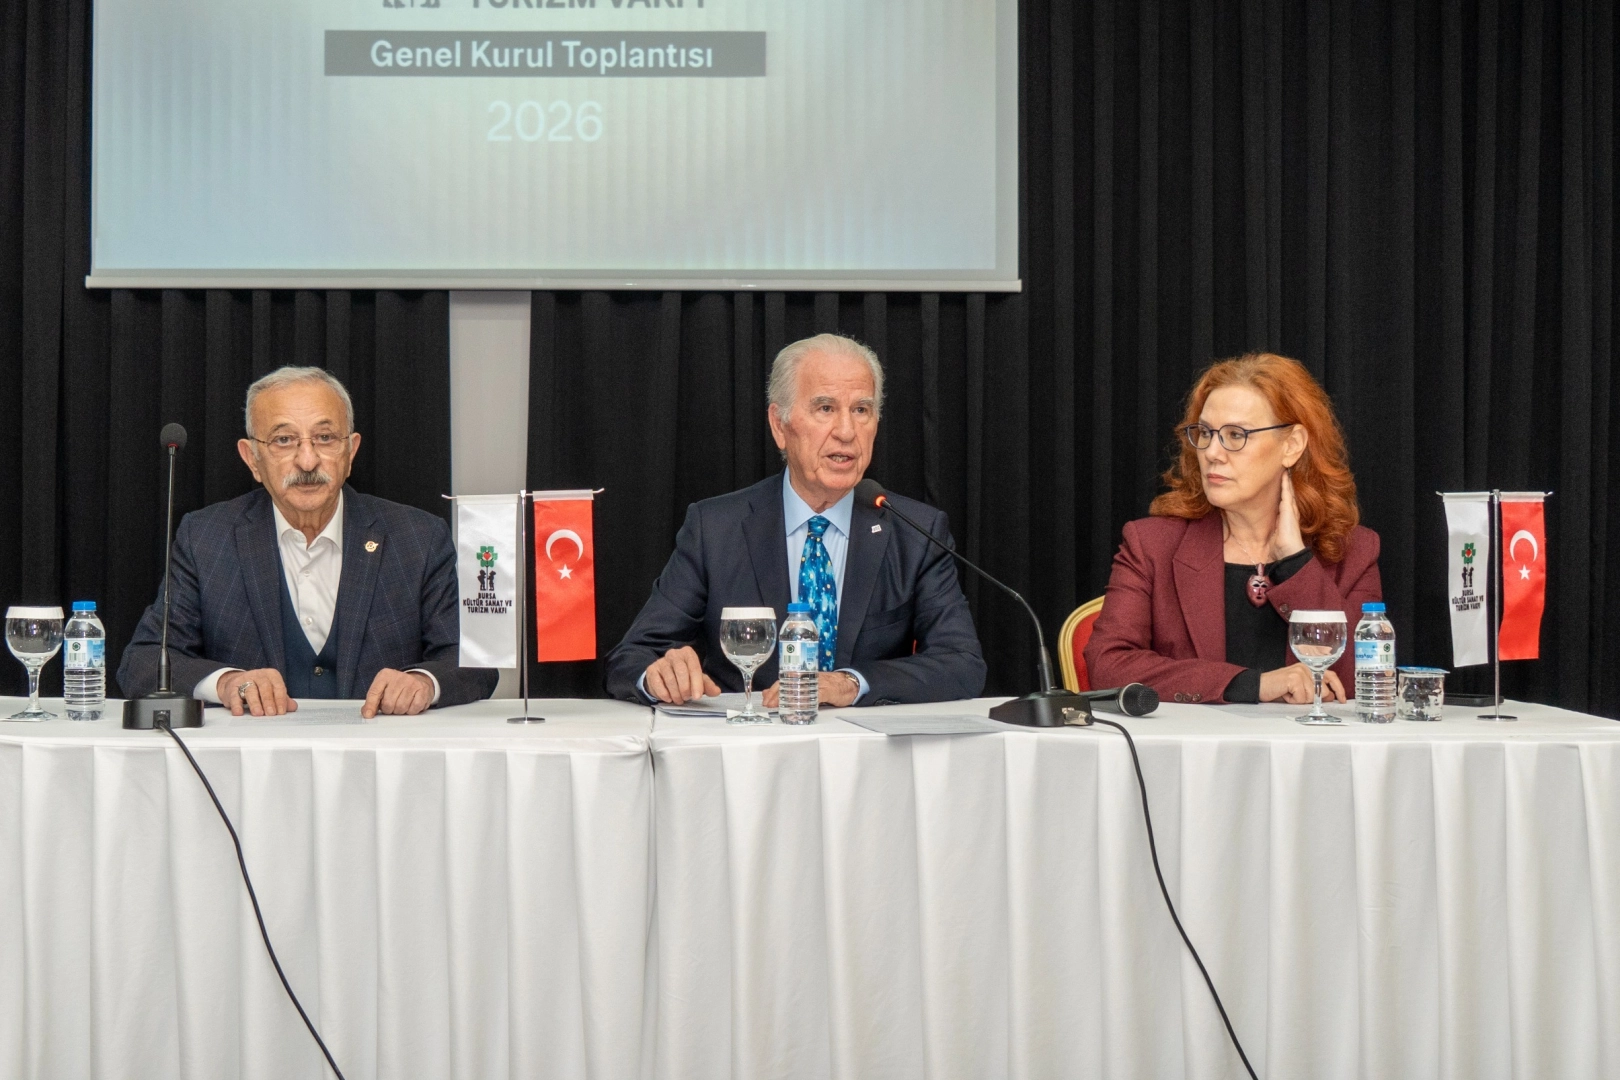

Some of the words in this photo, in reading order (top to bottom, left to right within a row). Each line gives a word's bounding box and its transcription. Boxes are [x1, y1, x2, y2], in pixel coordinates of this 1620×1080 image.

[370, 40, 461, 67] Genel
[471, 40, 552, 67] Kurul
[561, 40, 712, 74] Toplantısı
[487, 100, 603, 142] 2026
[463, 598, 483, 606] KÜLTÜR
[491, 606, 507, 614] VAKFI
